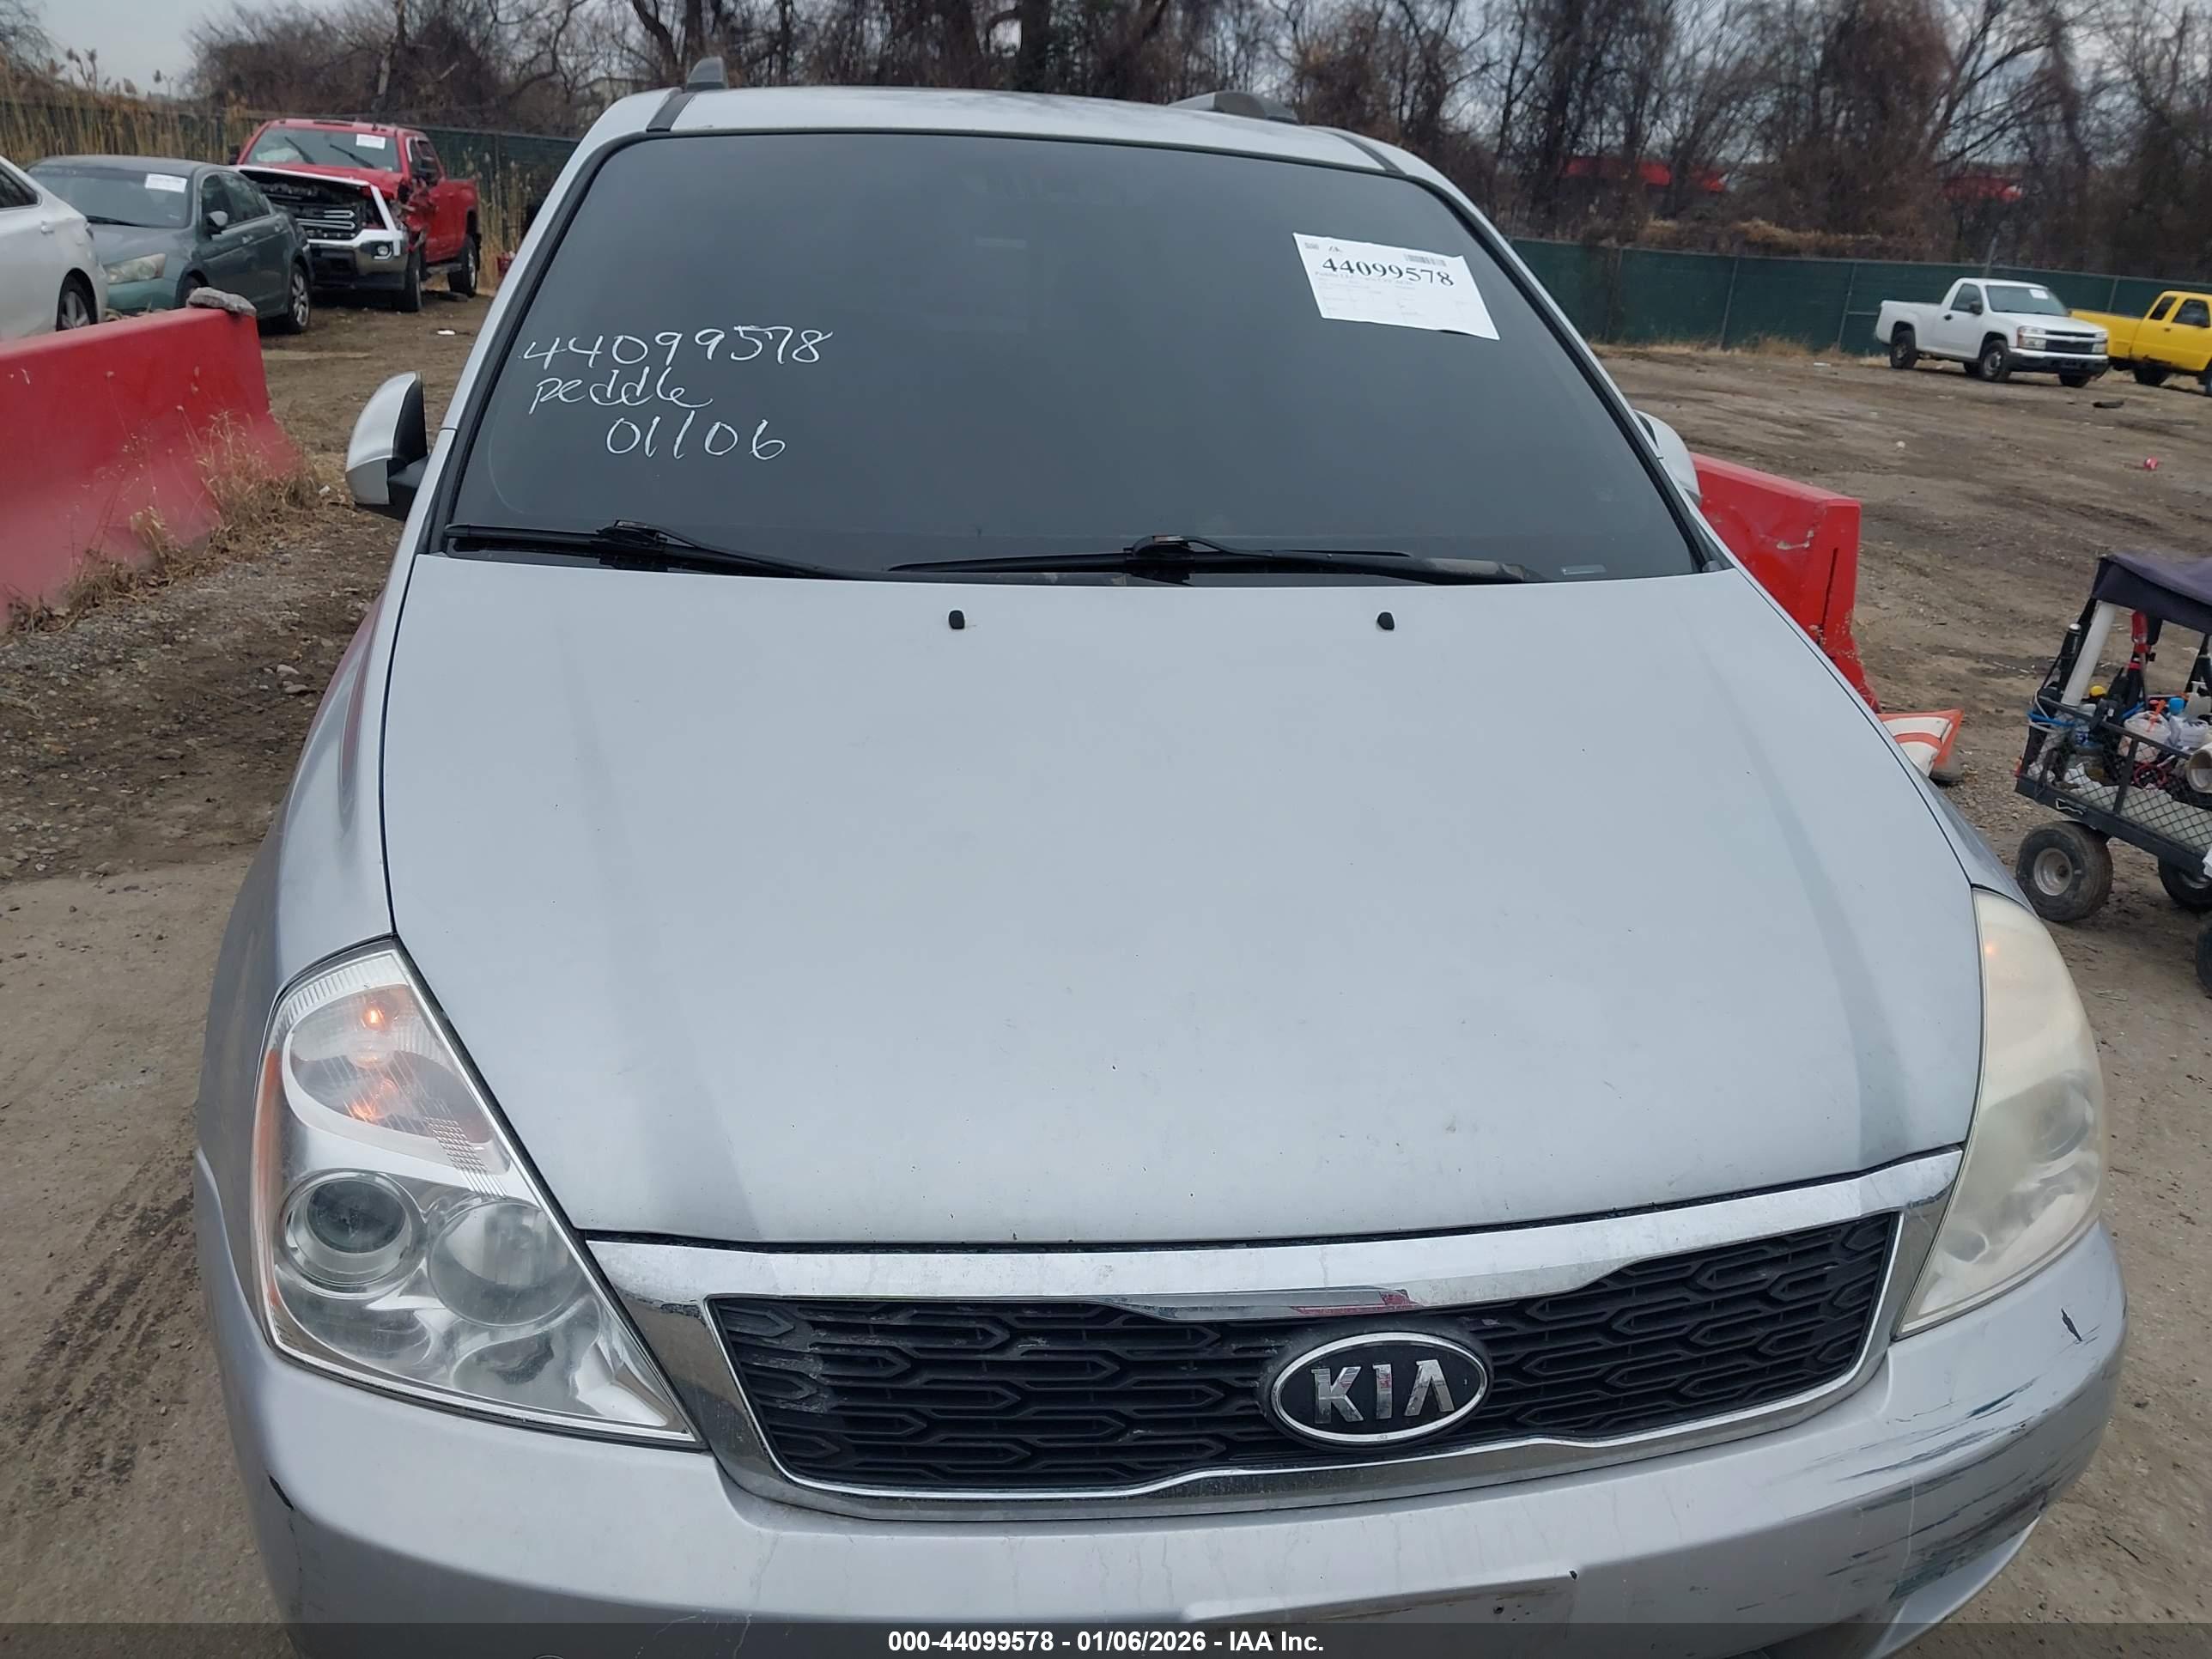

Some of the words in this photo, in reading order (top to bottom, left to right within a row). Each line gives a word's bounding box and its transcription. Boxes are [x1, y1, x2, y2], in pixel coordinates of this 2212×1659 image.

[1322, 258, 1455, 286] 44099578
[520, 325, 834, 370] 44099578
[1311, 1359, 1455, 1425] KIA
